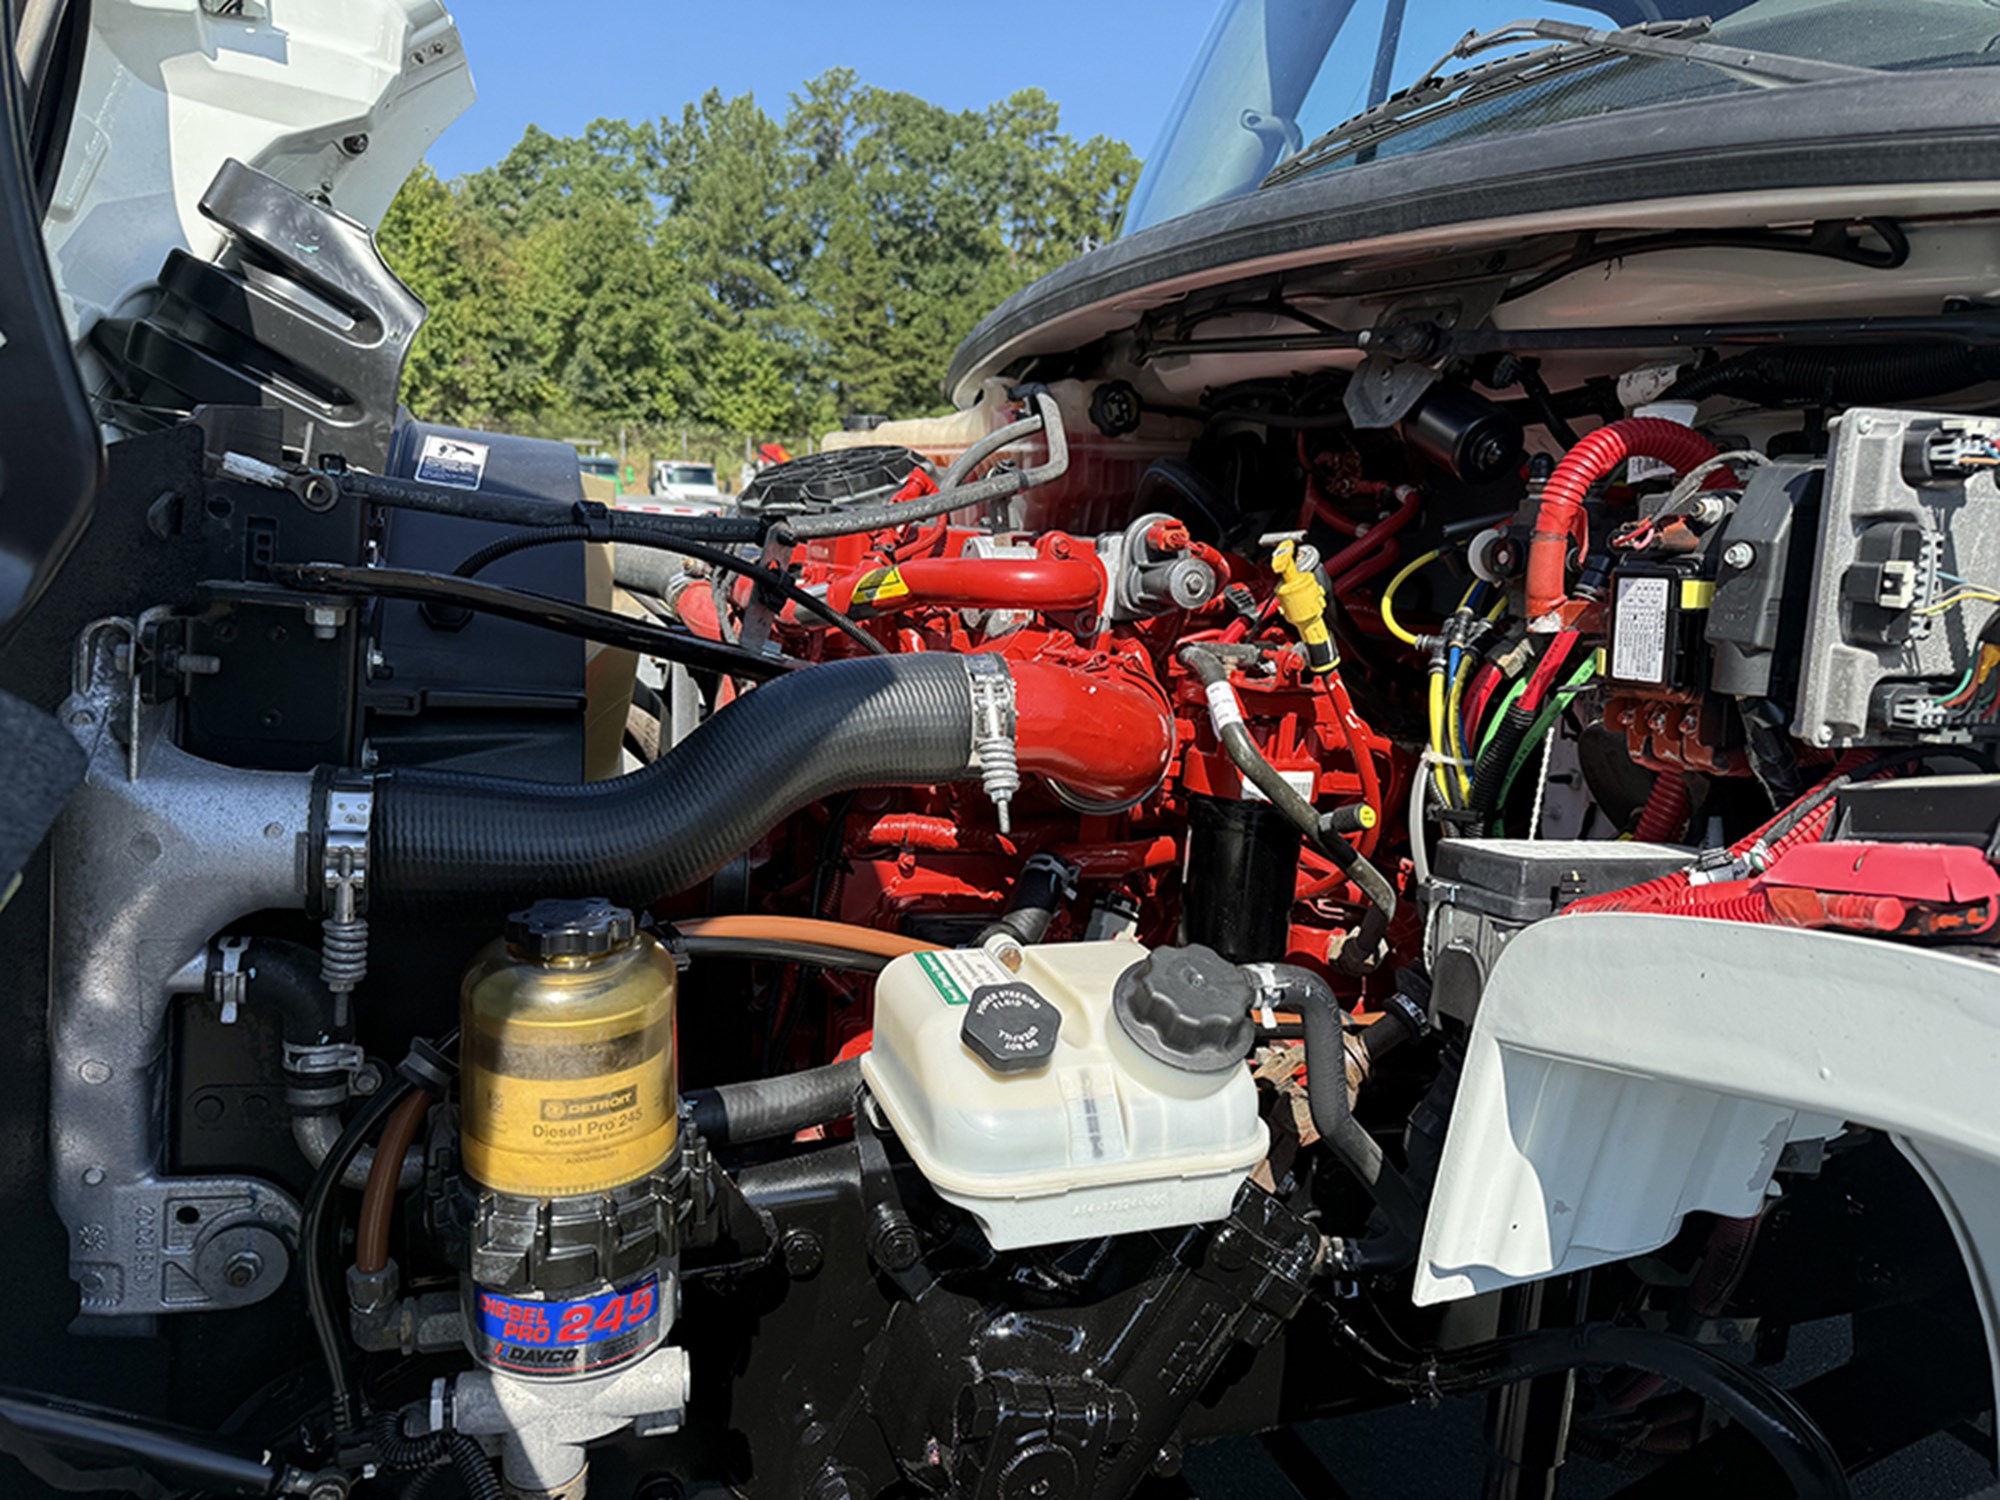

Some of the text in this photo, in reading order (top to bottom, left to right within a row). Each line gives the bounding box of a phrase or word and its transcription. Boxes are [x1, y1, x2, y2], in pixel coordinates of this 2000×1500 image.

[976, 990, 1041, 1015] POWER STEERING
[992, 999, 1022, 1010] FLUID
[1004, 1039, 1039, 1051] DO NOT
[568, 1093, 632, 1113] DETROIT
[532, 1123, 582, 1138] Diesel
[619, 1107, 642, 1127] 245
[479, 1294, 549, 1326] DIESEL
[557, 1281, 655, 1343] 245
[503, 1321, 550, 1343] PRO
[509, 1348, 579, 1363] DAVCO
